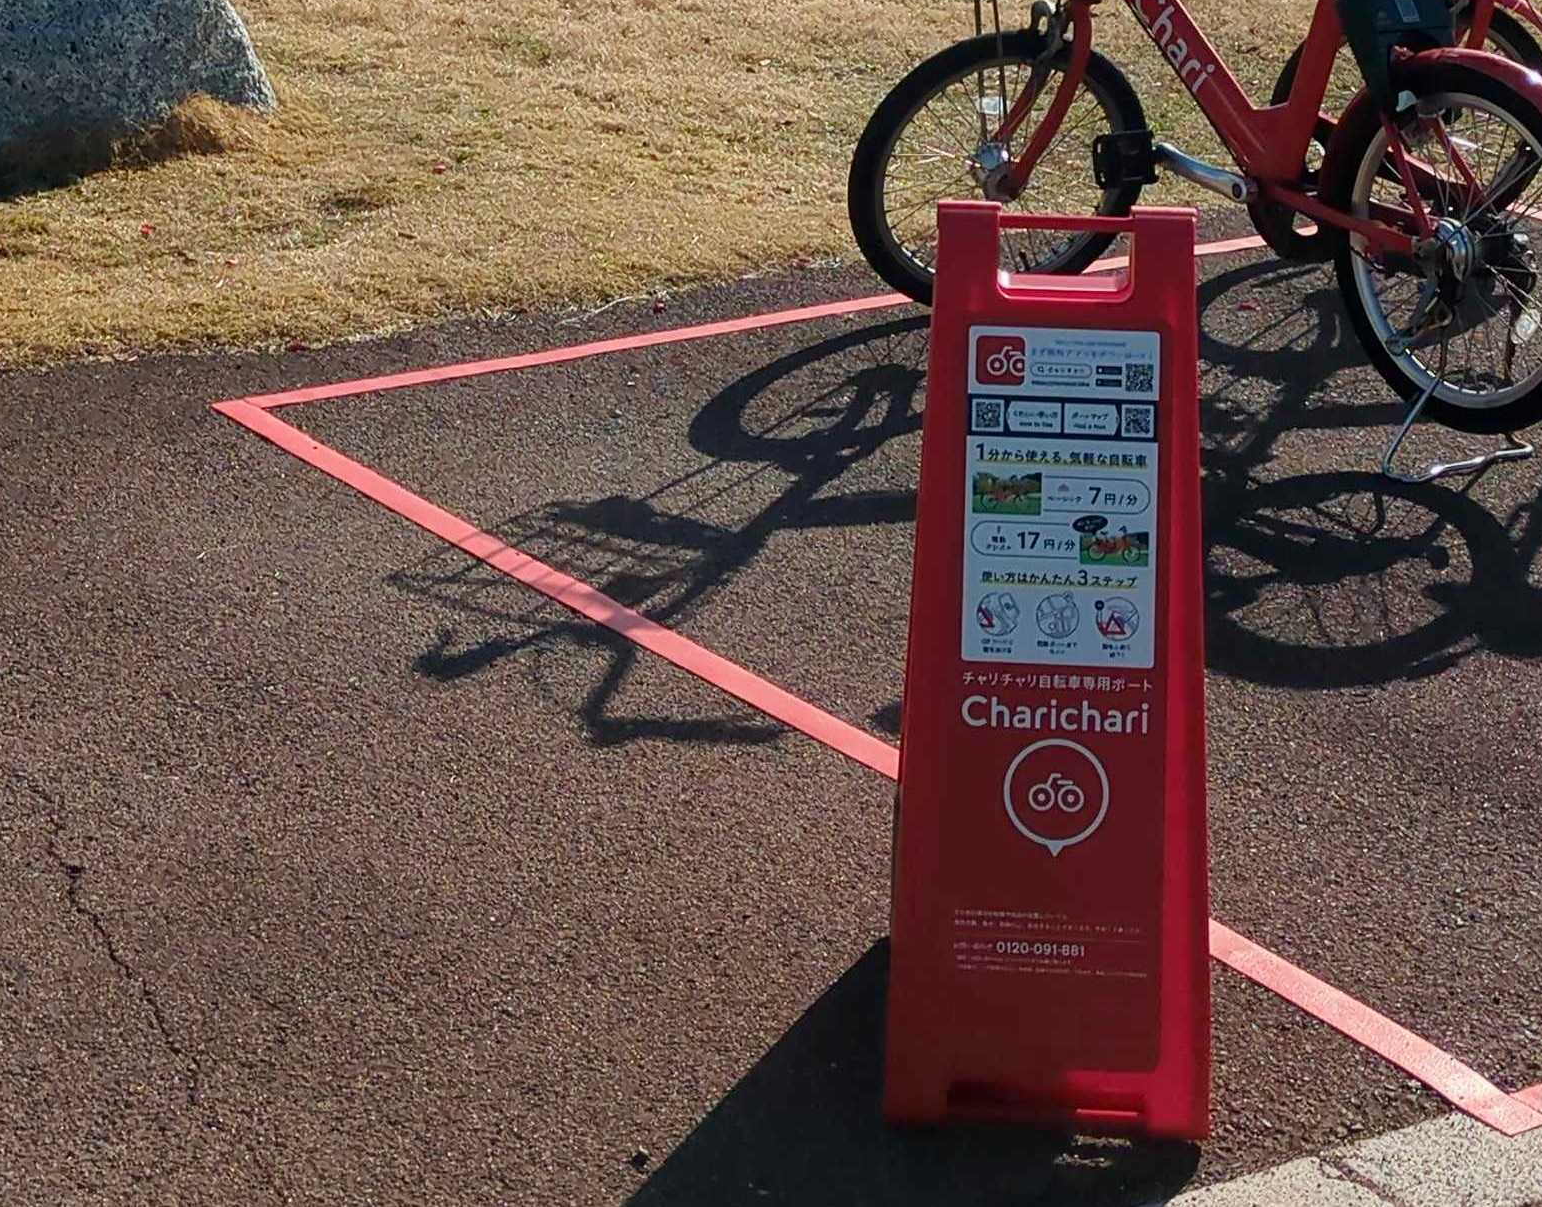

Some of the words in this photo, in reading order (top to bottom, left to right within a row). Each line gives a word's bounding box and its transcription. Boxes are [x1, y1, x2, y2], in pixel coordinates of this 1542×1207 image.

[962, 670, 1152, 692] チャリチャリ自転車専用ポート
[961, 695, 1150, 734] Charichari
[996, 941, 1085, 957] 0120-091-881
